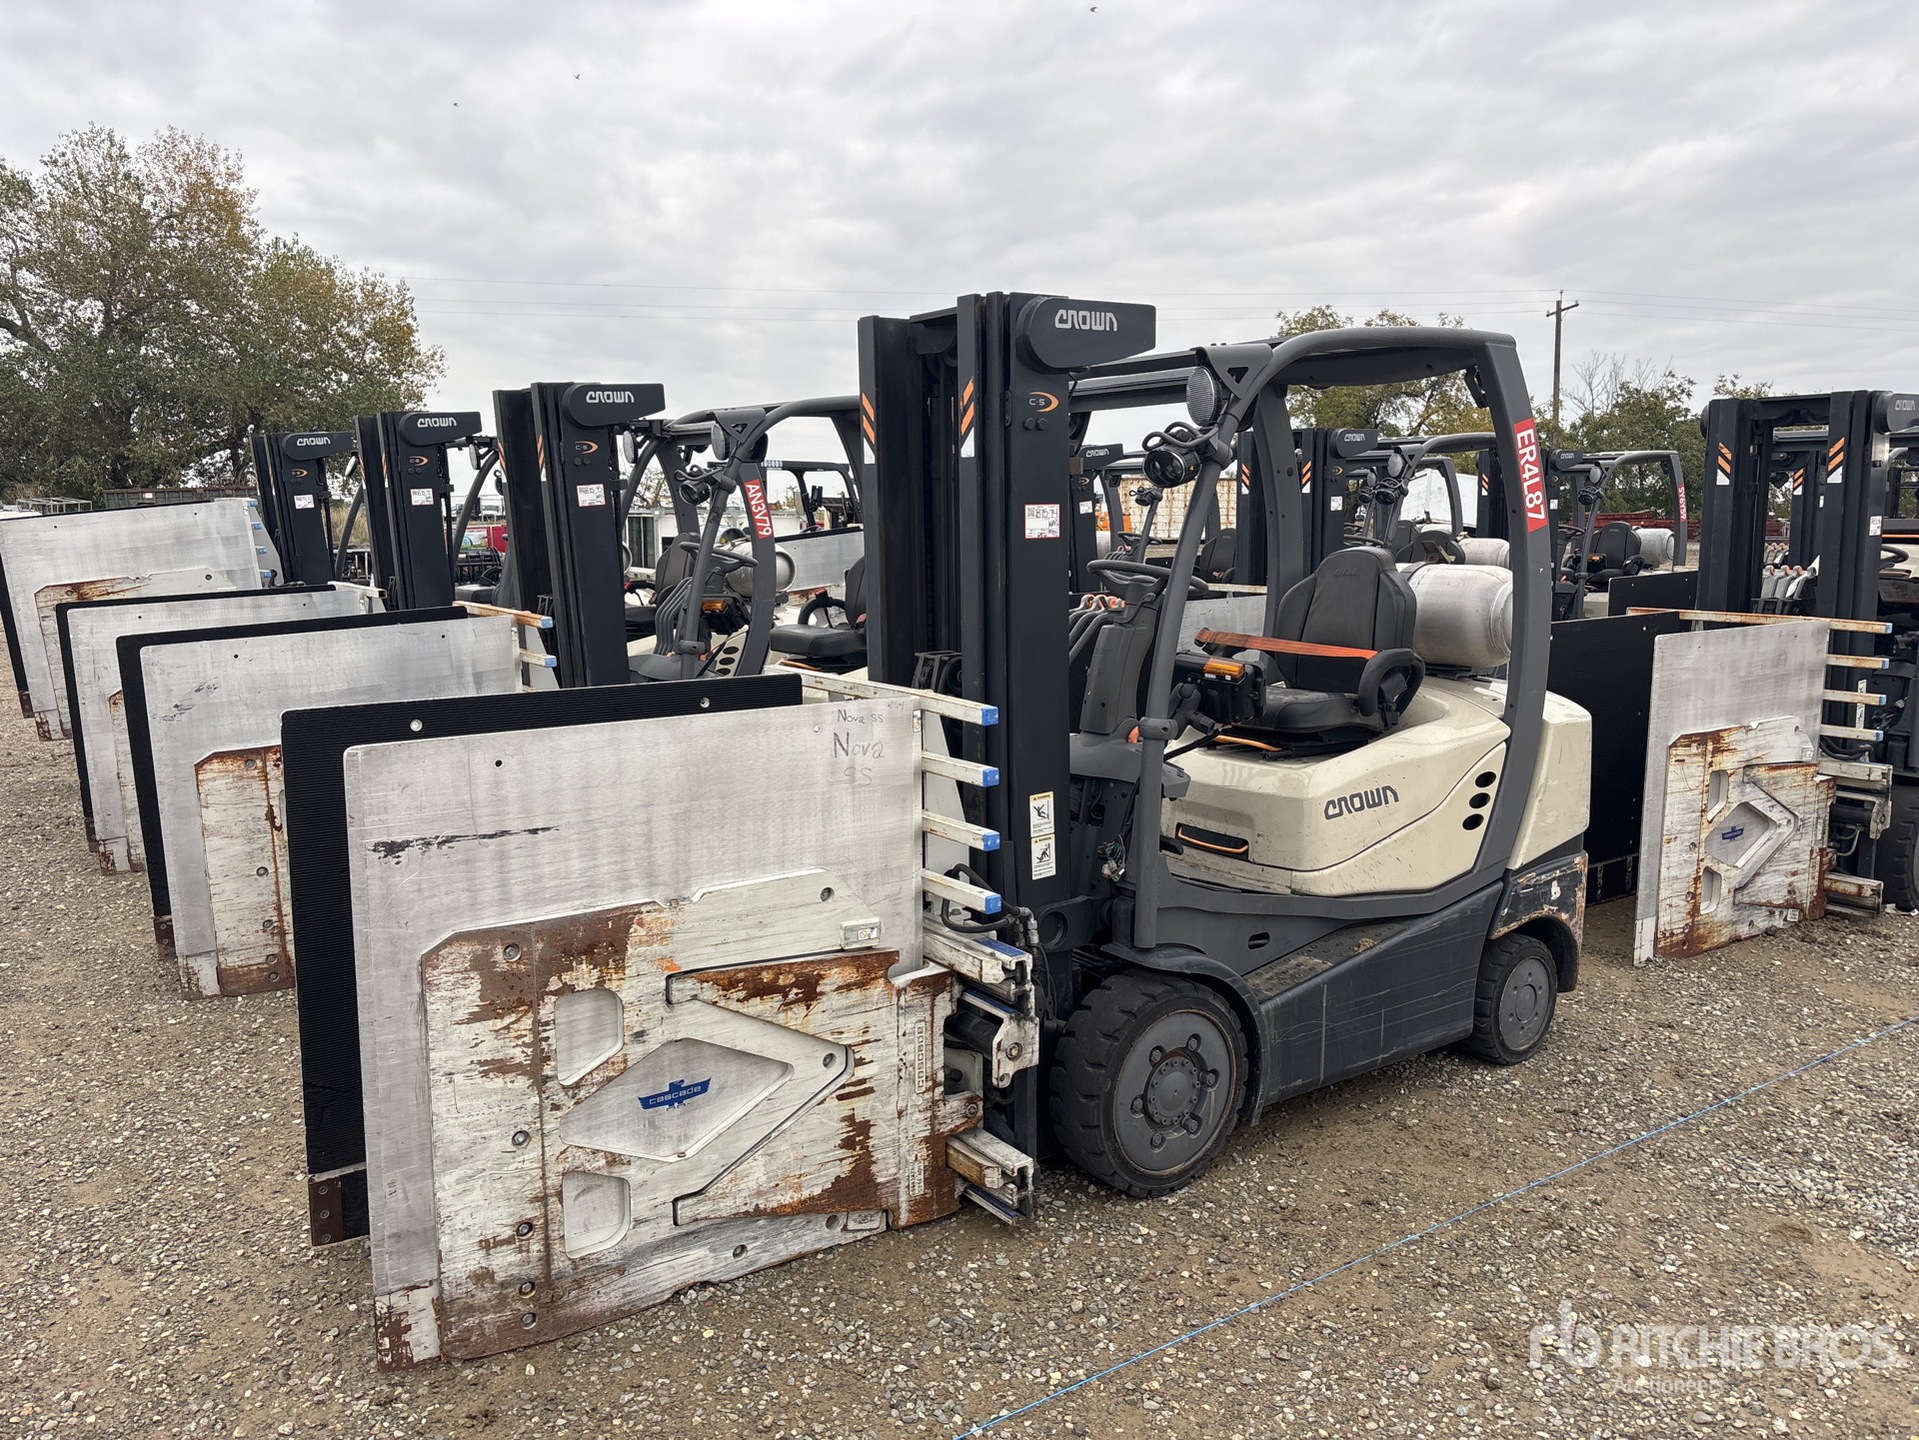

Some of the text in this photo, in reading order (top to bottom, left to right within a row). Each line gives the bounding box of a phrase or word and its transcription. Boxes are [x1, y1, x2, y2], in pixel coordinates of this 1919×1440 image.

[1055, 309, 1118, 332] CROWN
[586, 391, 635, 403] CROWN
[417, 417, 457, 428] CROWN
[296, 436, 331, 446] CROWN
[1516, 428, 1546, 520] ER4L87
[745, 484, 773, 536] AN3V79
[833, 731, 886, 760] Nova
[1323, 785, 1400, 821] CROWN
[648, 1085, 703, 1106] cascade
